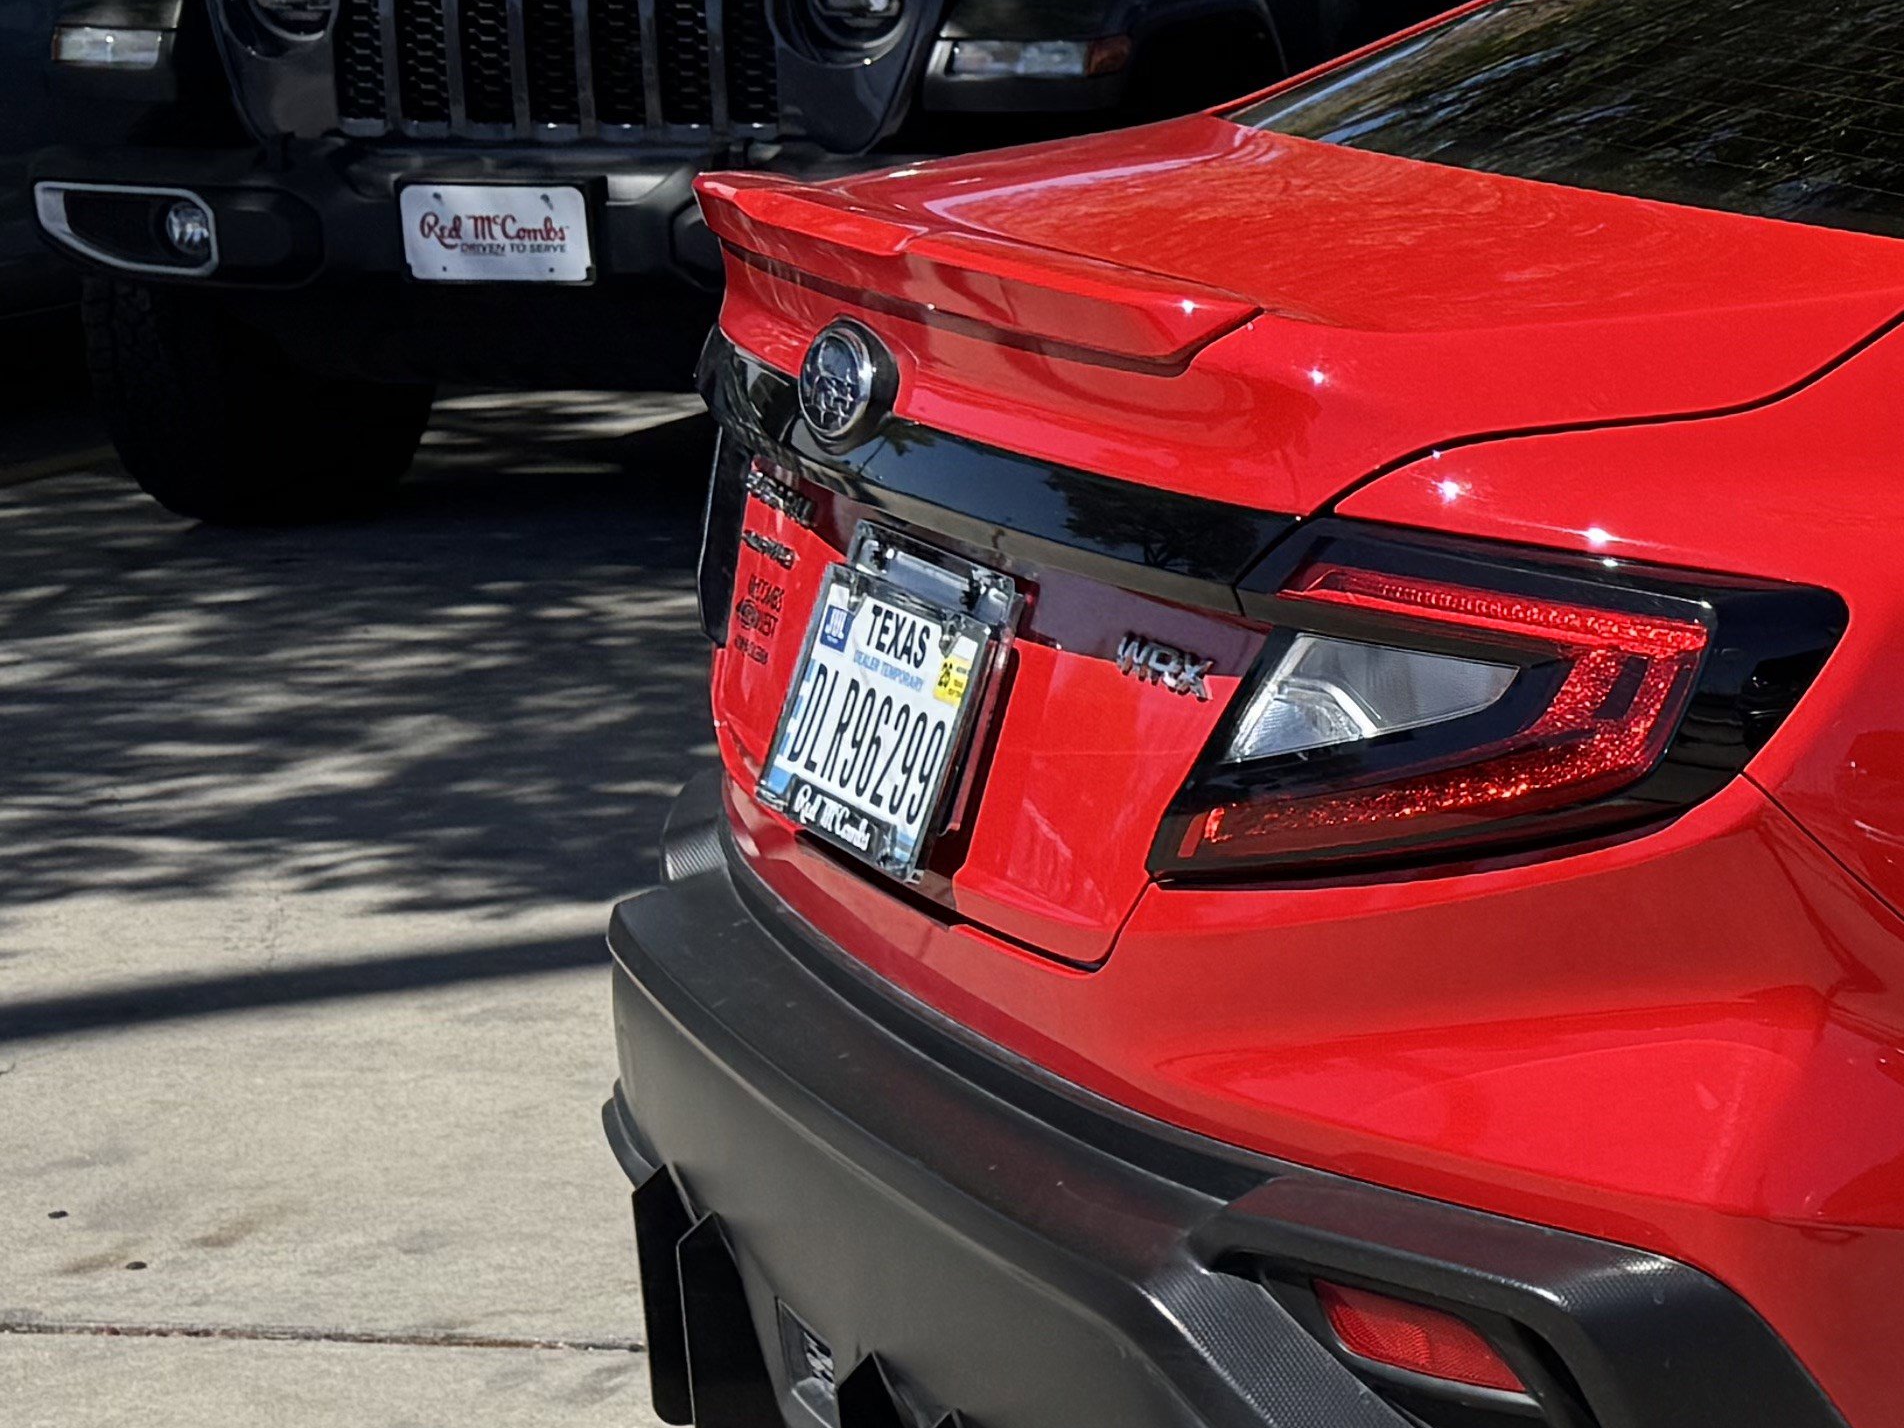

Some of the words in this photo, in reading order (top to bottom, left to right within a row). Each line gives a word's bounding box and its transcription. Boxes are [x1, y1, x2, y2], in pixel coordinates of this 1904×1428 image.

[419, 212, 462, 249] Red
[466, 214, 566, 242] McCombs
[461, 243, 505, 254] DRIVEN
[510, 243, 526, 254] TO
[530, 243, 566, 254] SERVE
[866, 604, 930, 669] TEXAS
[787, 663, 946, 825] DLR96299
